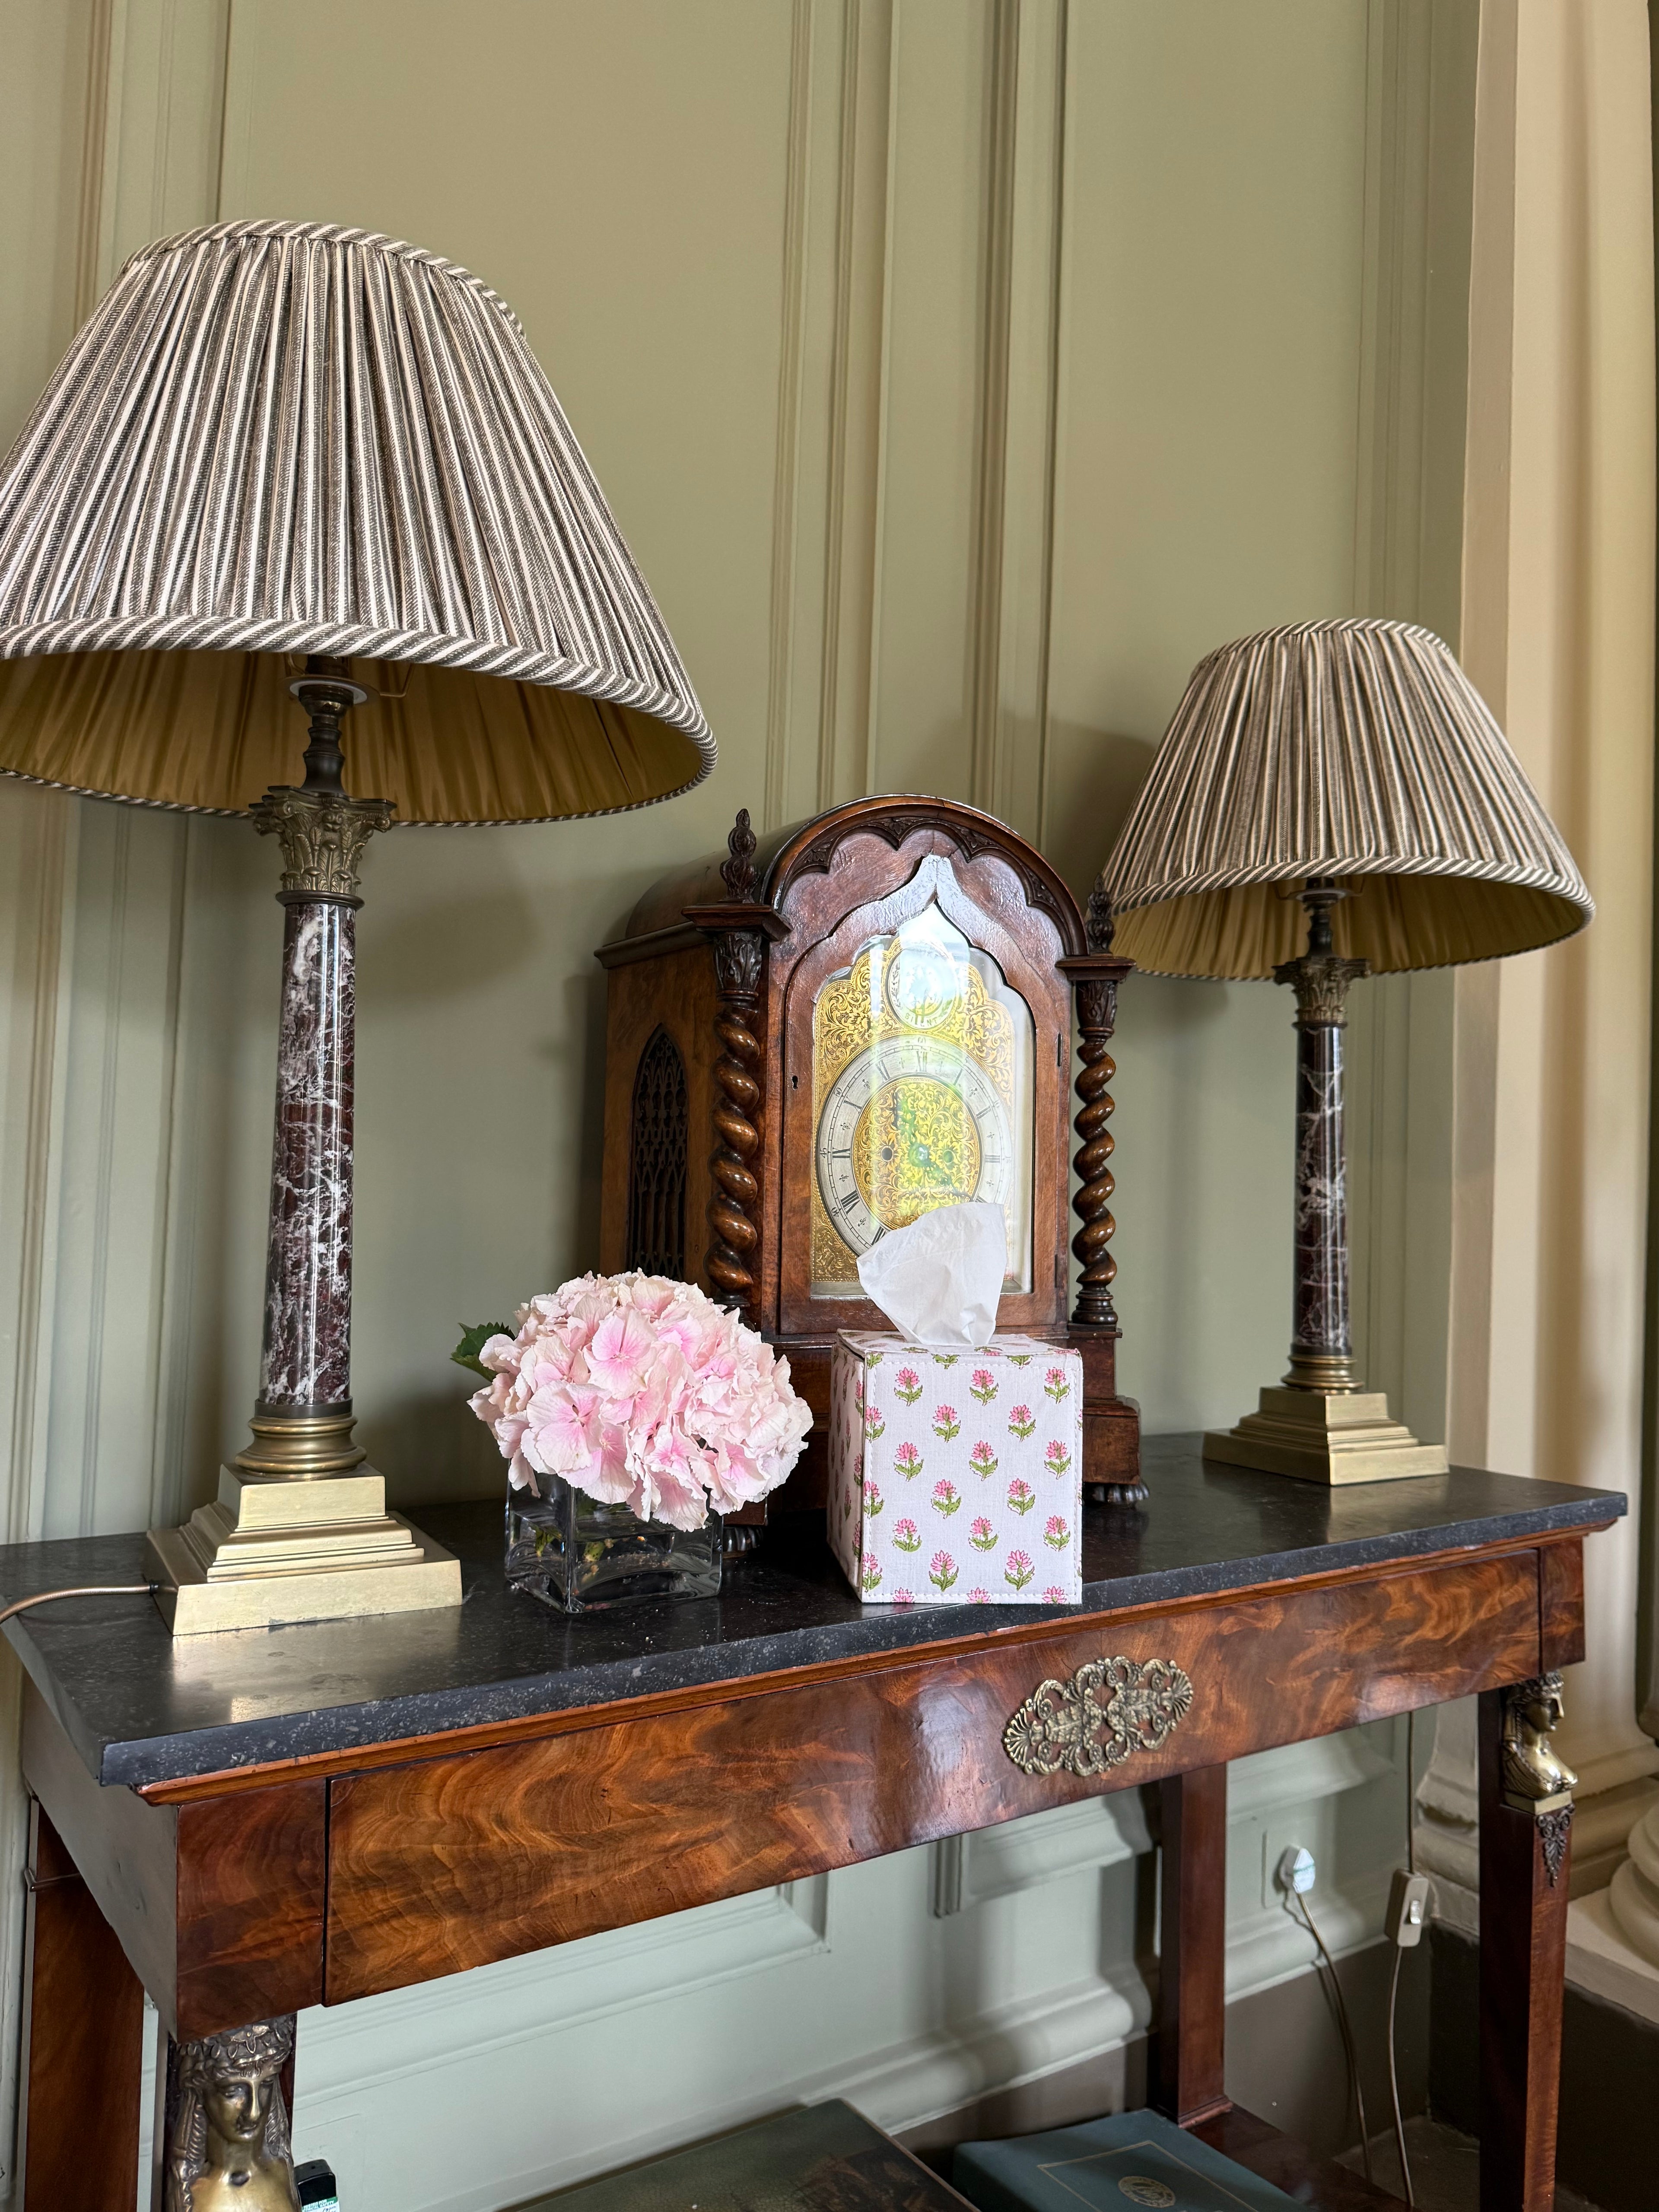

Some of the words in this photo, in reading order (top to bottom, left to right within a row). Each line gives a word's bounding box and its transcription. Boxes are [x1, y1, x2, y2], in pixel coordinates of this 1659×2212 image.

[834, 1087, 842, 1097] 50
[843, 1095, 863, 1114] X
[976, 1105, 992, 1120] II
[820, 1147, 827, 1158] 45
[832, 1147, 851, 1161] IX
[985, 1154, 1001, 1163] III
[841, 1189, 861, 1215] VIII
[831, 1207, 839, 1217] 40
